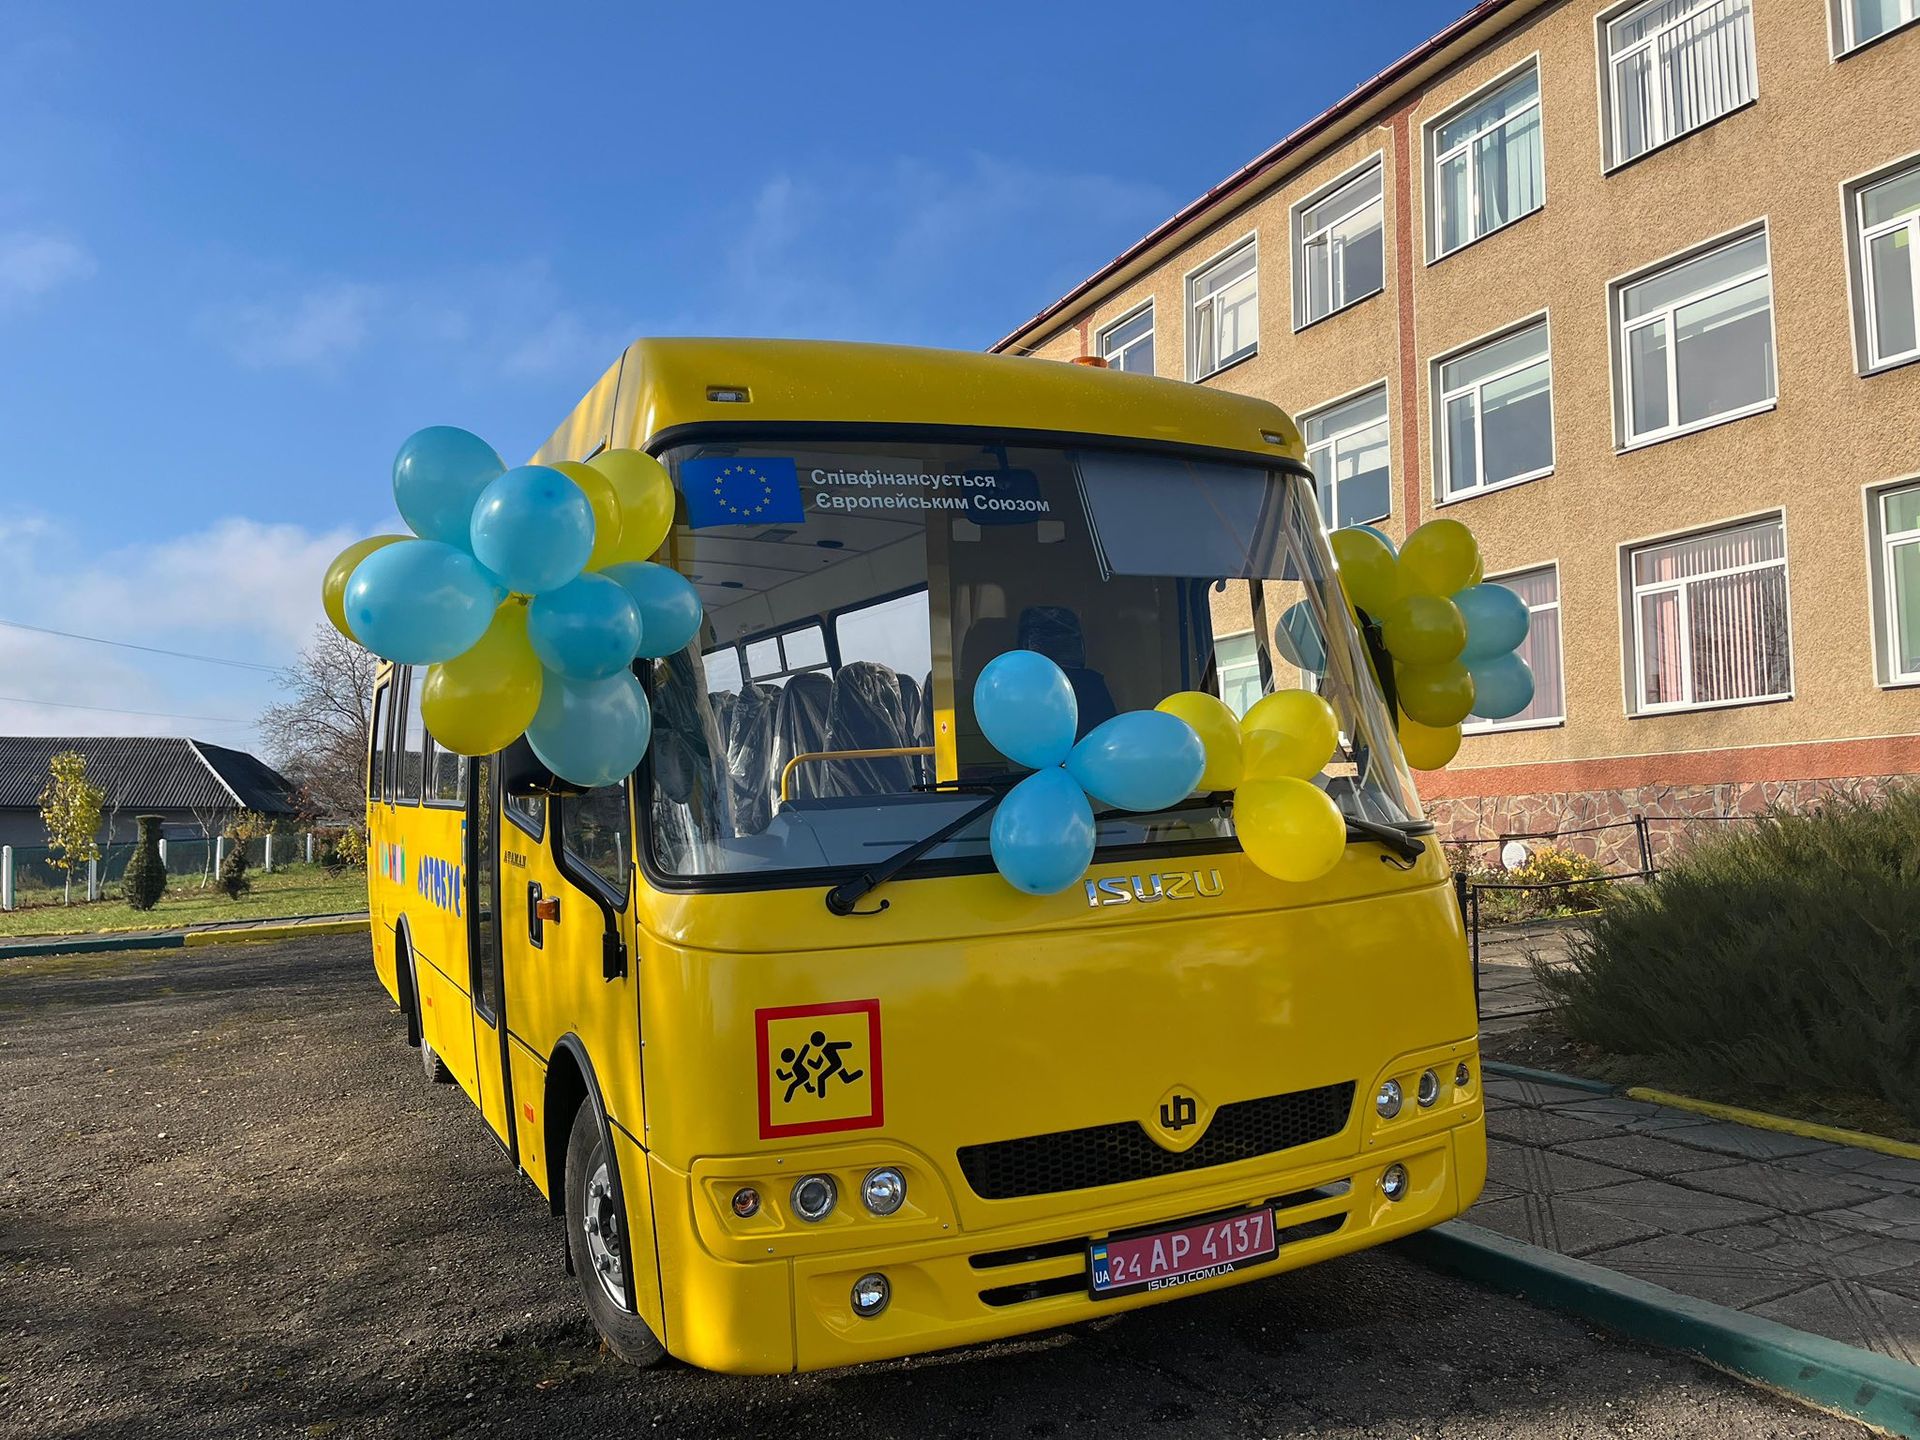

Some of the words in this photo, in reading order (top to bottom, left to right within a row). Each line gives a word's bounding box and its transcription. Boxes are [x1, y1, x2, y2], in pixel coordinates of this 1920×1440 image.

[811, 468, 997, 490] Співфінансується
[815, 492, 969, 512] Європейським
[973, 494, 1051, 512] Союзом
[418, 854, 461, 918] АВТОБУС
[1084, 869, 1224, 907] ISUZU
[1112, 1253, 1142, 1281] 24
[1202, 1215, 1263, 1260] 4137
[1095, 1269, 1110, 1284] UA
[1147, 1262, 1235, 1292] ISUZU.COM.UA
